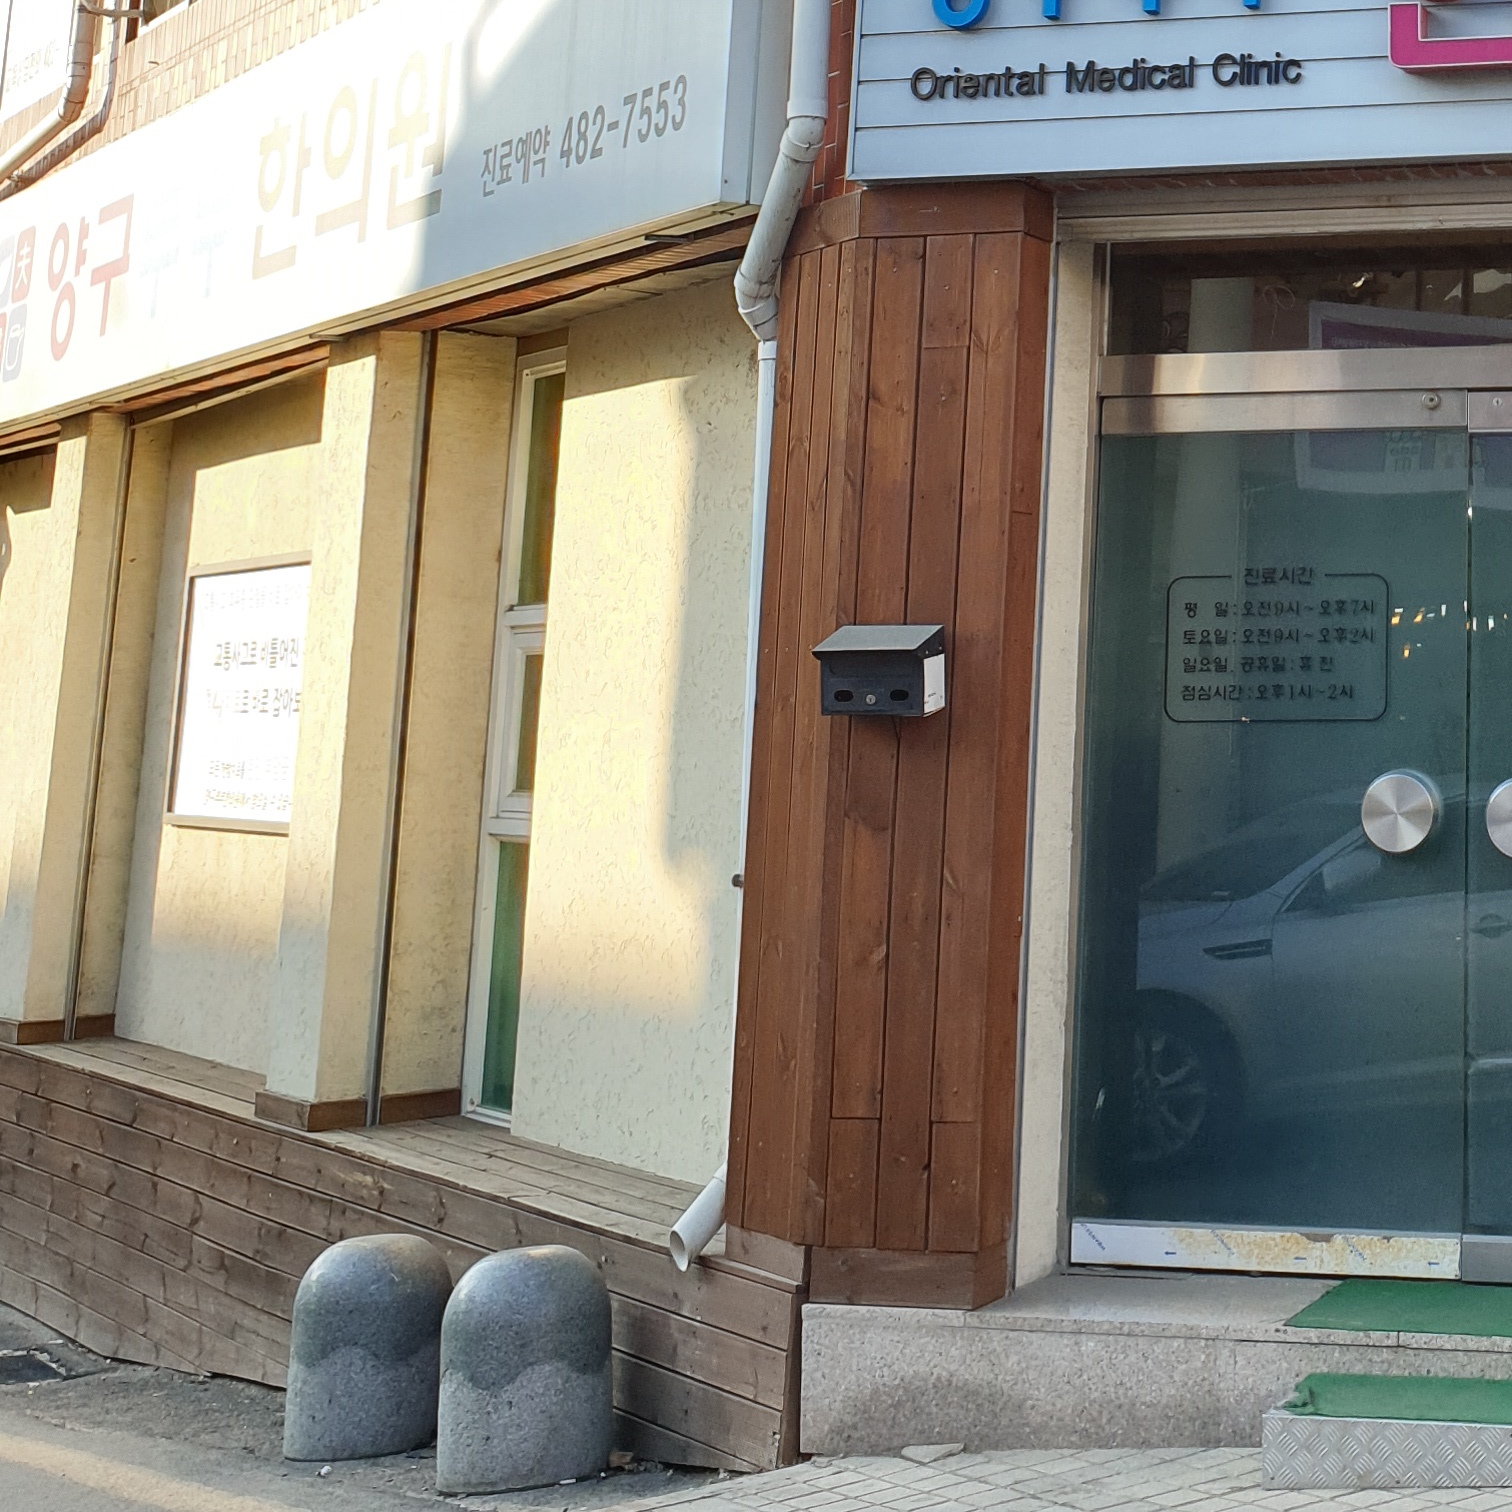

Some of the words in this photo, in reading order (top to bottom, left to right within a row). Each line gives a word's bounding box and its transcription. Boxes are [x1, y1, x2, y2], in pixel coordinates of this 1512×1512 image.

[911, 61, 1048, 102] Oriental
[1064, 53, 1195, 93] Medical
[1212, 51, 1303, 88] Clinic
[252, 41, 453, 280] 한의원
[481, 125, 551, 199] 진료예약
[560, 73, 689, 170] 482-7553
[1243, 566, 1315, 586] 진료시간
